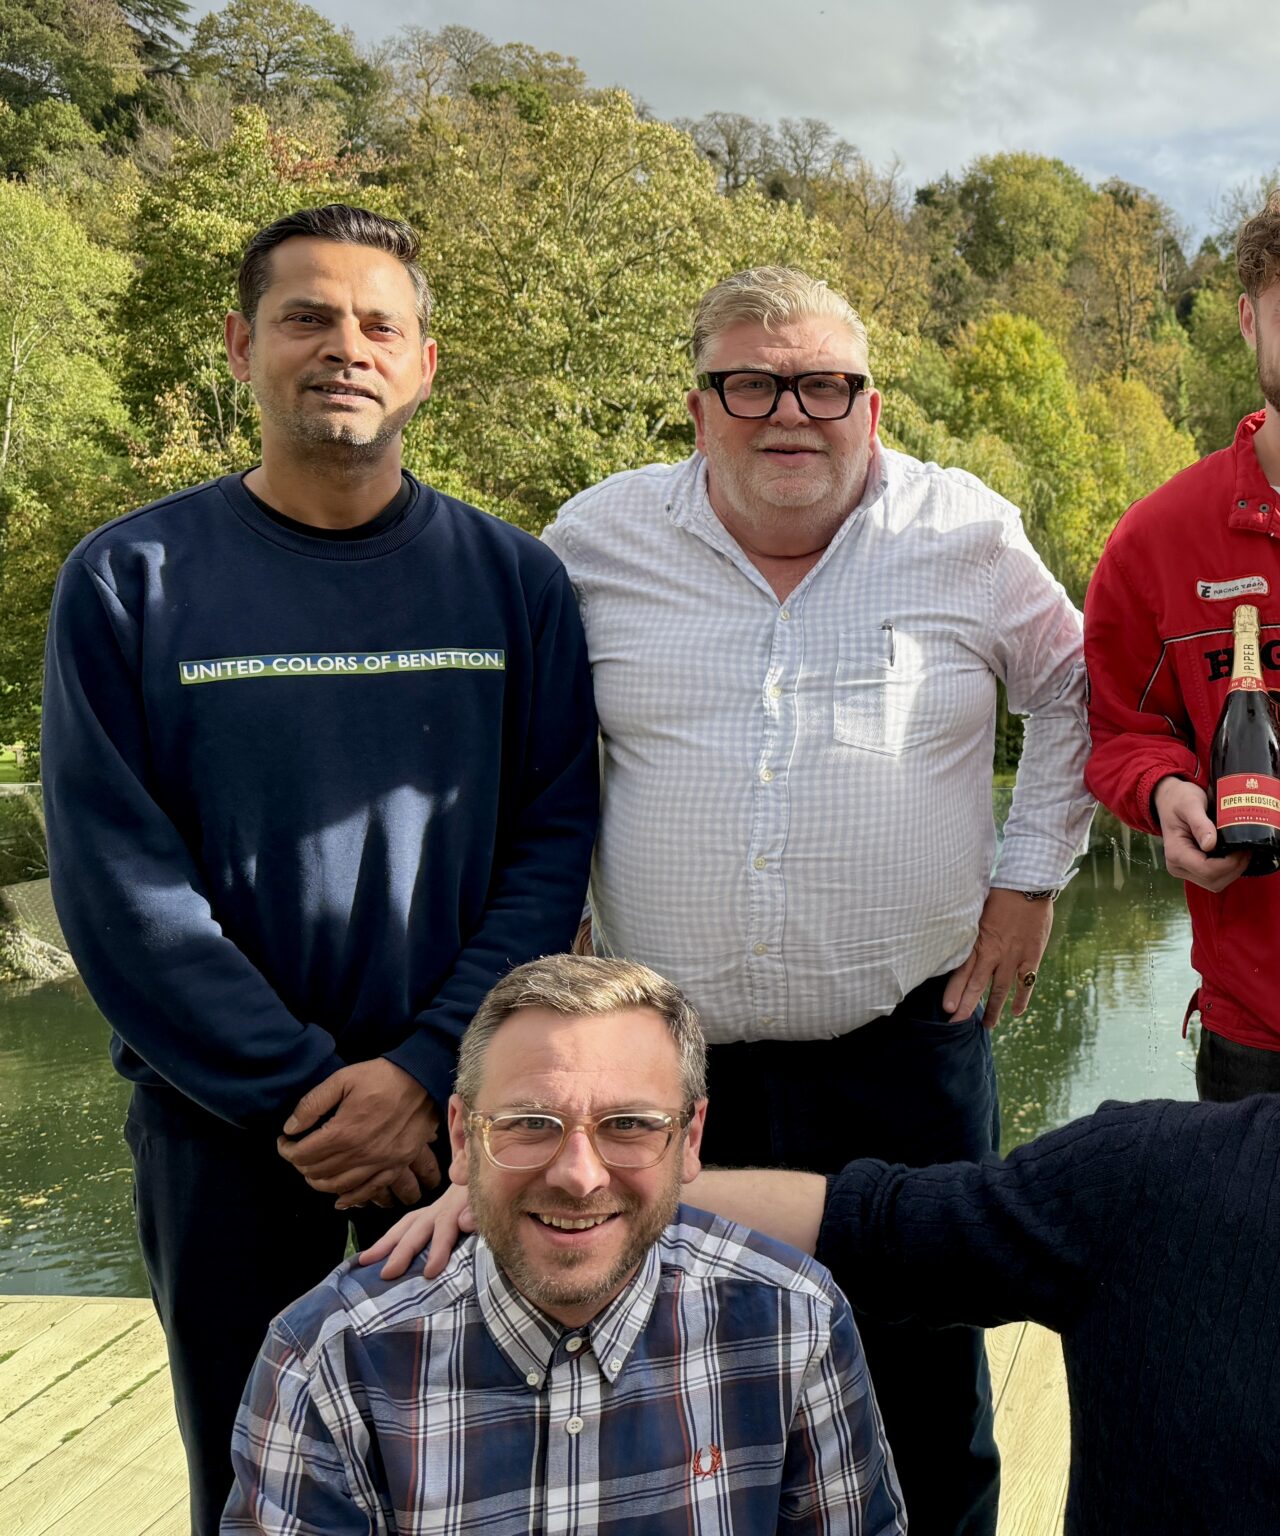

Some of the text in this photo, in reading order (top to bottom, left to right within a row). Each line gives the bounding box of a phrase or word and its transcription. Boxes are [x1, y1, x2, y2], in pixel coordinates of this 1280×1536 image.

[182, 659, 265, 681] UNITED
[272, 656, 358, 672] COLORS
[364, 655, 391, 671] OF
[1243, 644, 1255, 671] PIPER
